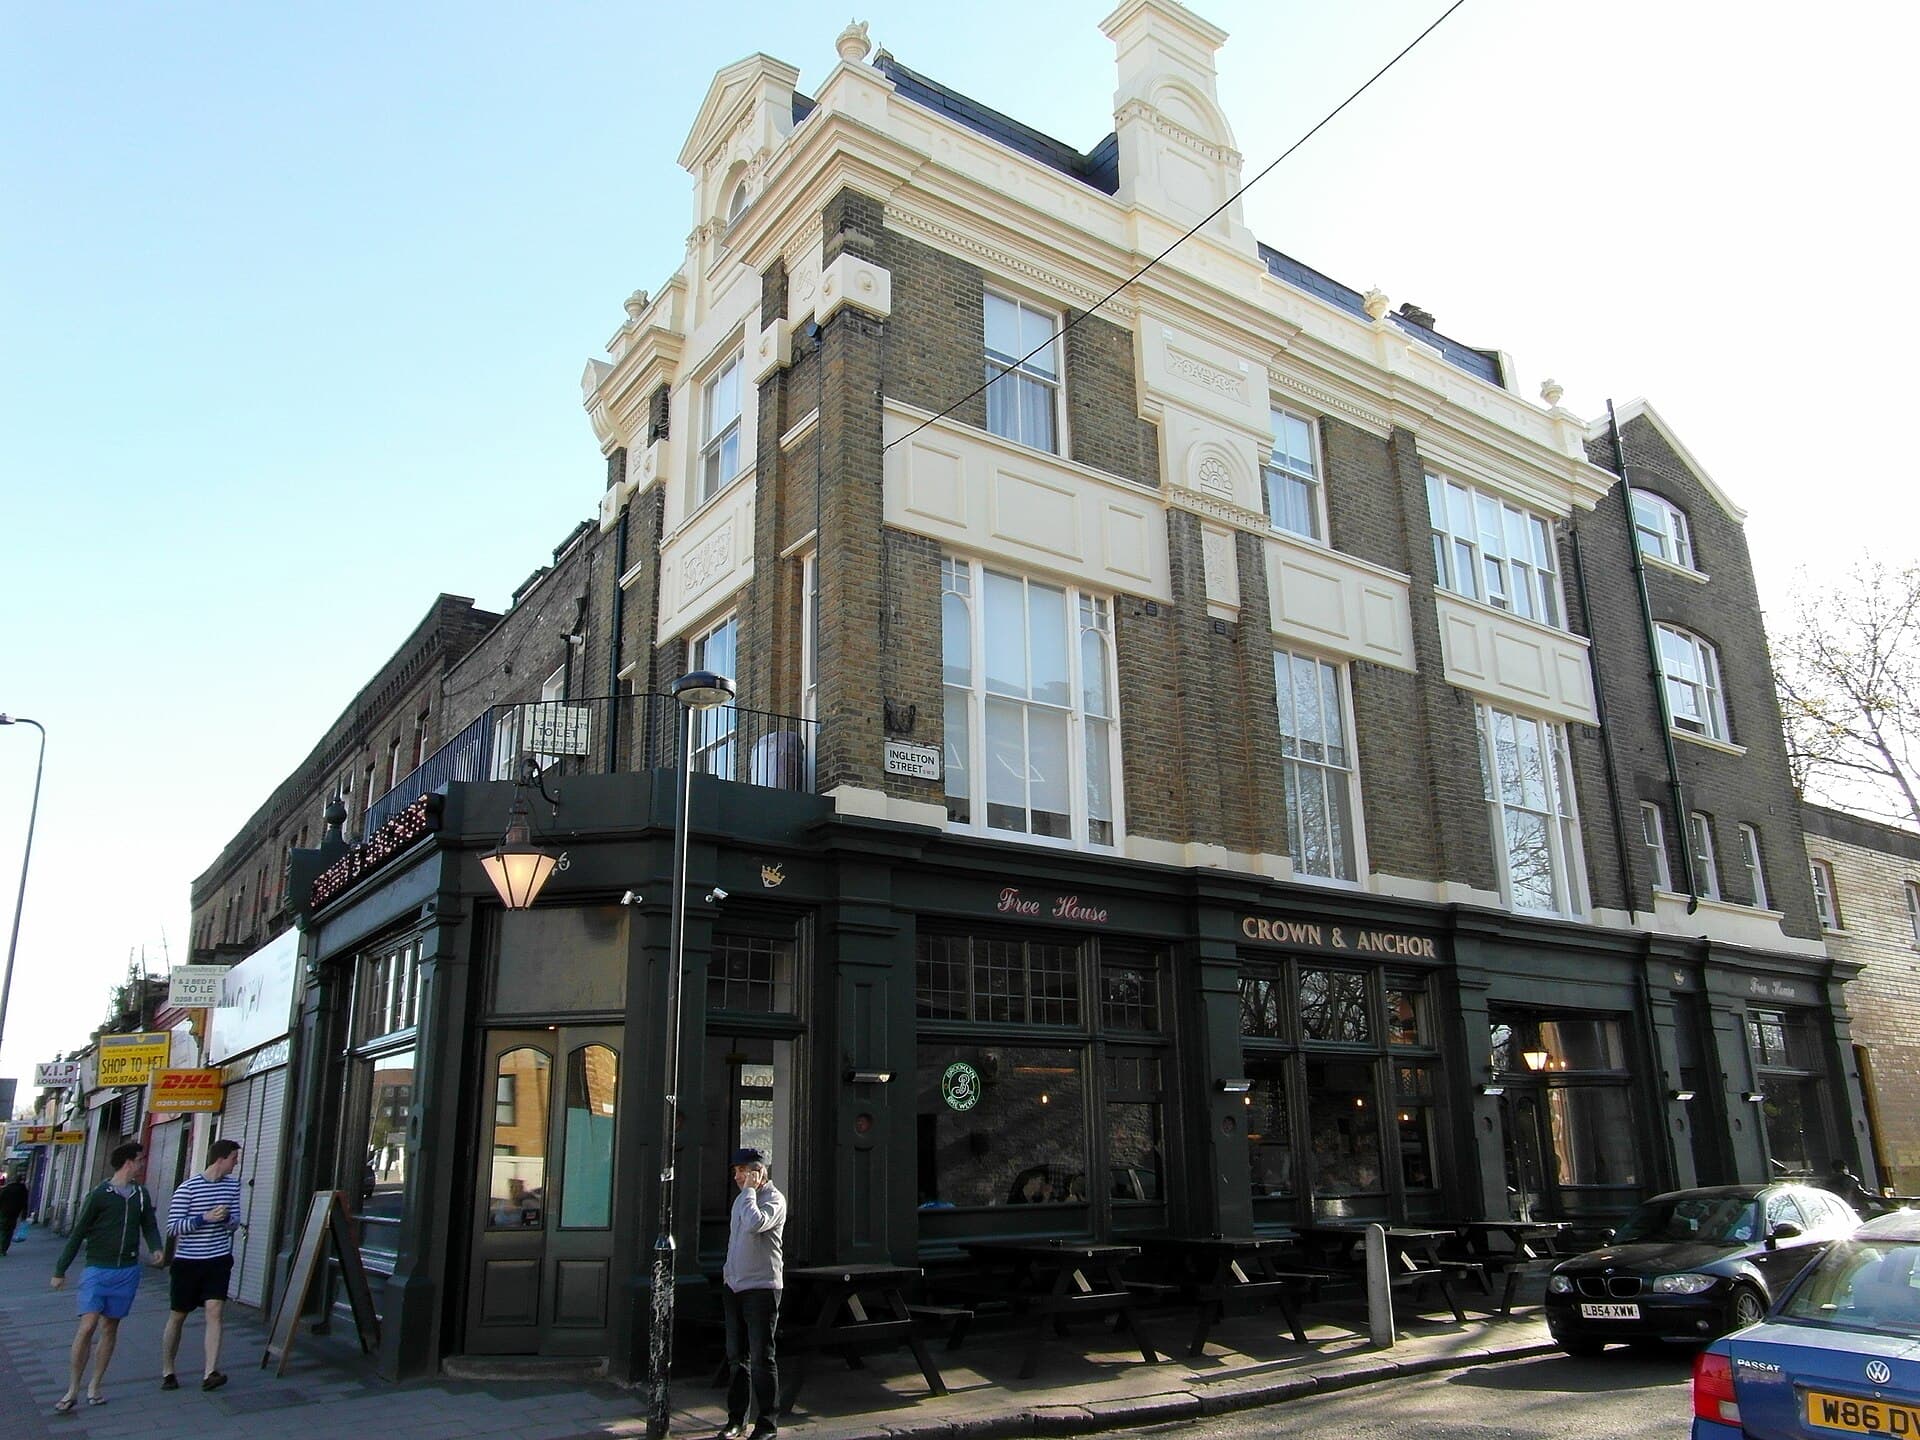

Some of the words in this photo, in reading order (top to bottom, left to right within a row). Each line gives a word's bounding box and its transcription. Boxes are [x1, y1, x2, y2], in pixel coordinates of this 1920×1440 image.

[538, 728, 553, 736] TO
[889, 750, 935, 765] INGLETON
[890, 761, 923, 774] STREET
[997, 887, 1040, 914] Free
[1052, 895, 1108, 922] House
[1242, 917, 1322, 946] CROWN
[1331, 927, 1348, 949] &
[1358, 931, 1437, 959] ANCHOR
[183, 985, 198, 994] TO
[101, 1058, 127, 1075] SHOP
[131, 1057, 142, 1073] TO
[945, 1063, 976, 1079] BROOKLYN
[37, 1077, 73, 1086] LOUNGE
[103, 1076, 118, 1084] 020
[161, 1073, 213, 1089] DHL
[947, 1096, 975, 1110] BREWERY
[1585, 1305, 1610, 1316] LB54
[1737, 1359, 1780, 1373] PASSAT
[1822, 1398, 1881, 1431] W86
